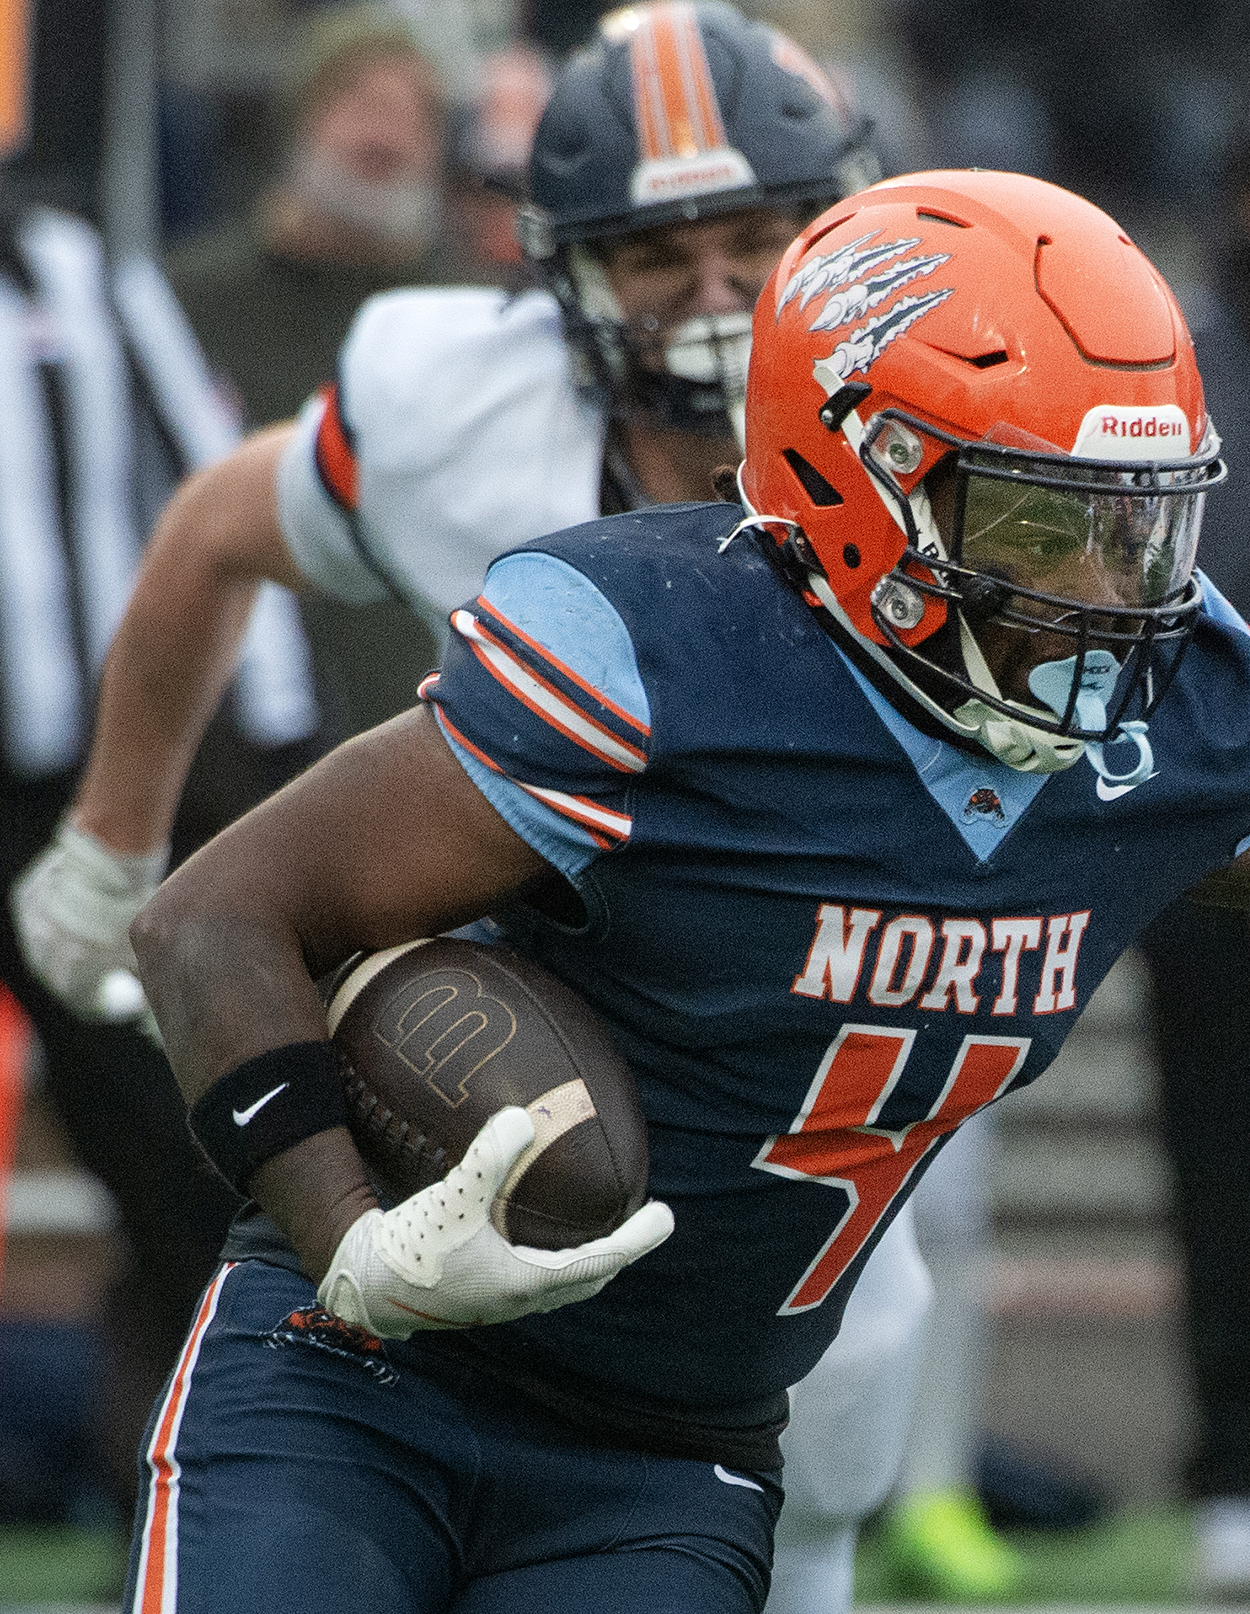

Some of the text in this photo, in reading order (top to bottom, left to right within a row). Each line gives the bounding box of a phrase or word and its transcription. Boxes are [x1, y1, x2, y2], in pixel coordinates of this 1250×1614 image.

[1101, 415, 1183, 438] Riddell
[790, 902, 1092, 1016] NORTH
[749, 1022, 1033, 1317] 4
